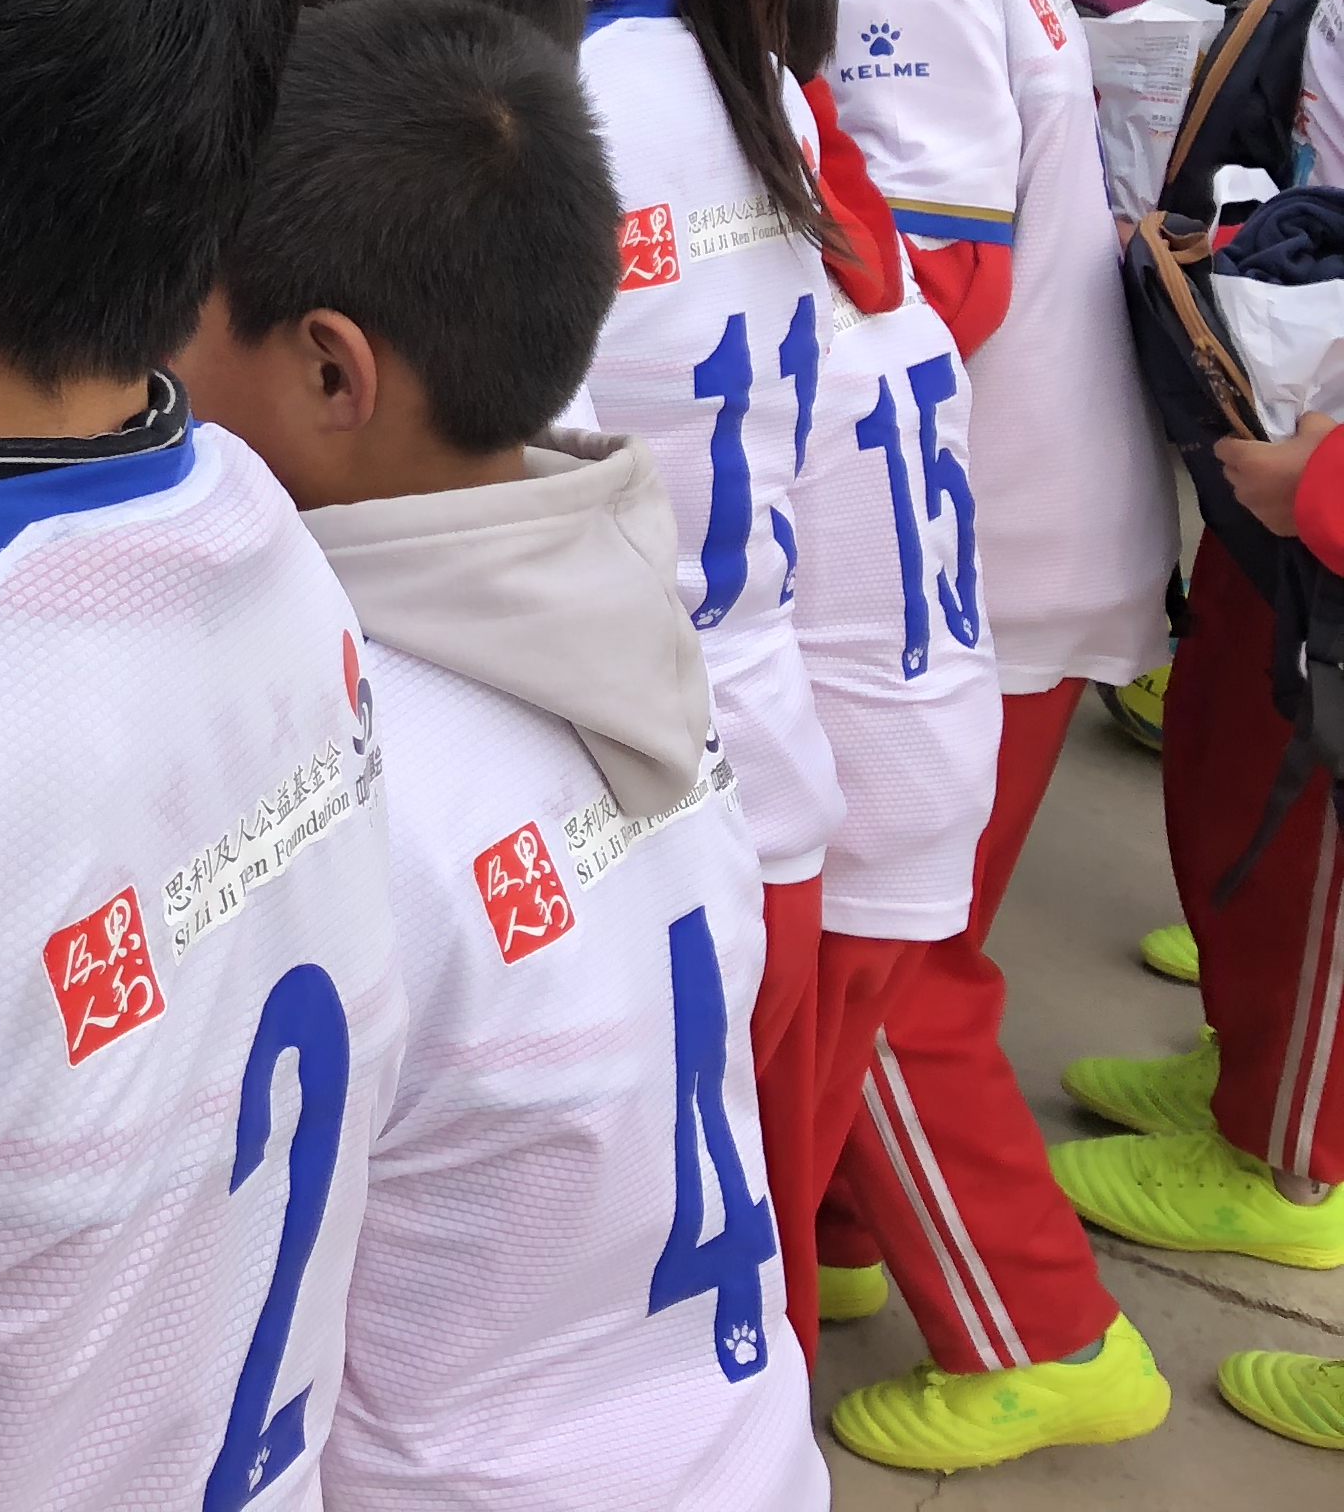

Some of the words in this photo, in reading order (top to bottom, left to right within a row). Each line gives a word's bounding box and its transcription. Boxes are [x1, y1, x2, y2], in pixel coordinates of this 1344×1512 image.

[840, 62, 930, 83] KELME
[690, 242, 701, 258] Si
[703, 238, 715, 255] Li
[718, 234, 728, 250] Ji
[730, 231, 750, 247] Ren
[690, 293, 819, 631] 11
[856, 352, 979, 681] 15
[164, 740, 342, 916] 思利及人公益基金会
[175, 922, 190, 956] Si
[195, 900, 212, 935] Li
[219, 882, 238, 914] Ji
[273, 791, 351, 868] Foundation
[576, 858, 593, 885] Si
[593, 845, 609, 872] Li
[609, 834, 624, 860] Ji
[620, 820, 643, 848] Ren
[646, 905, 777, 1384] 4
[202, 963, 350, 1512] 2
